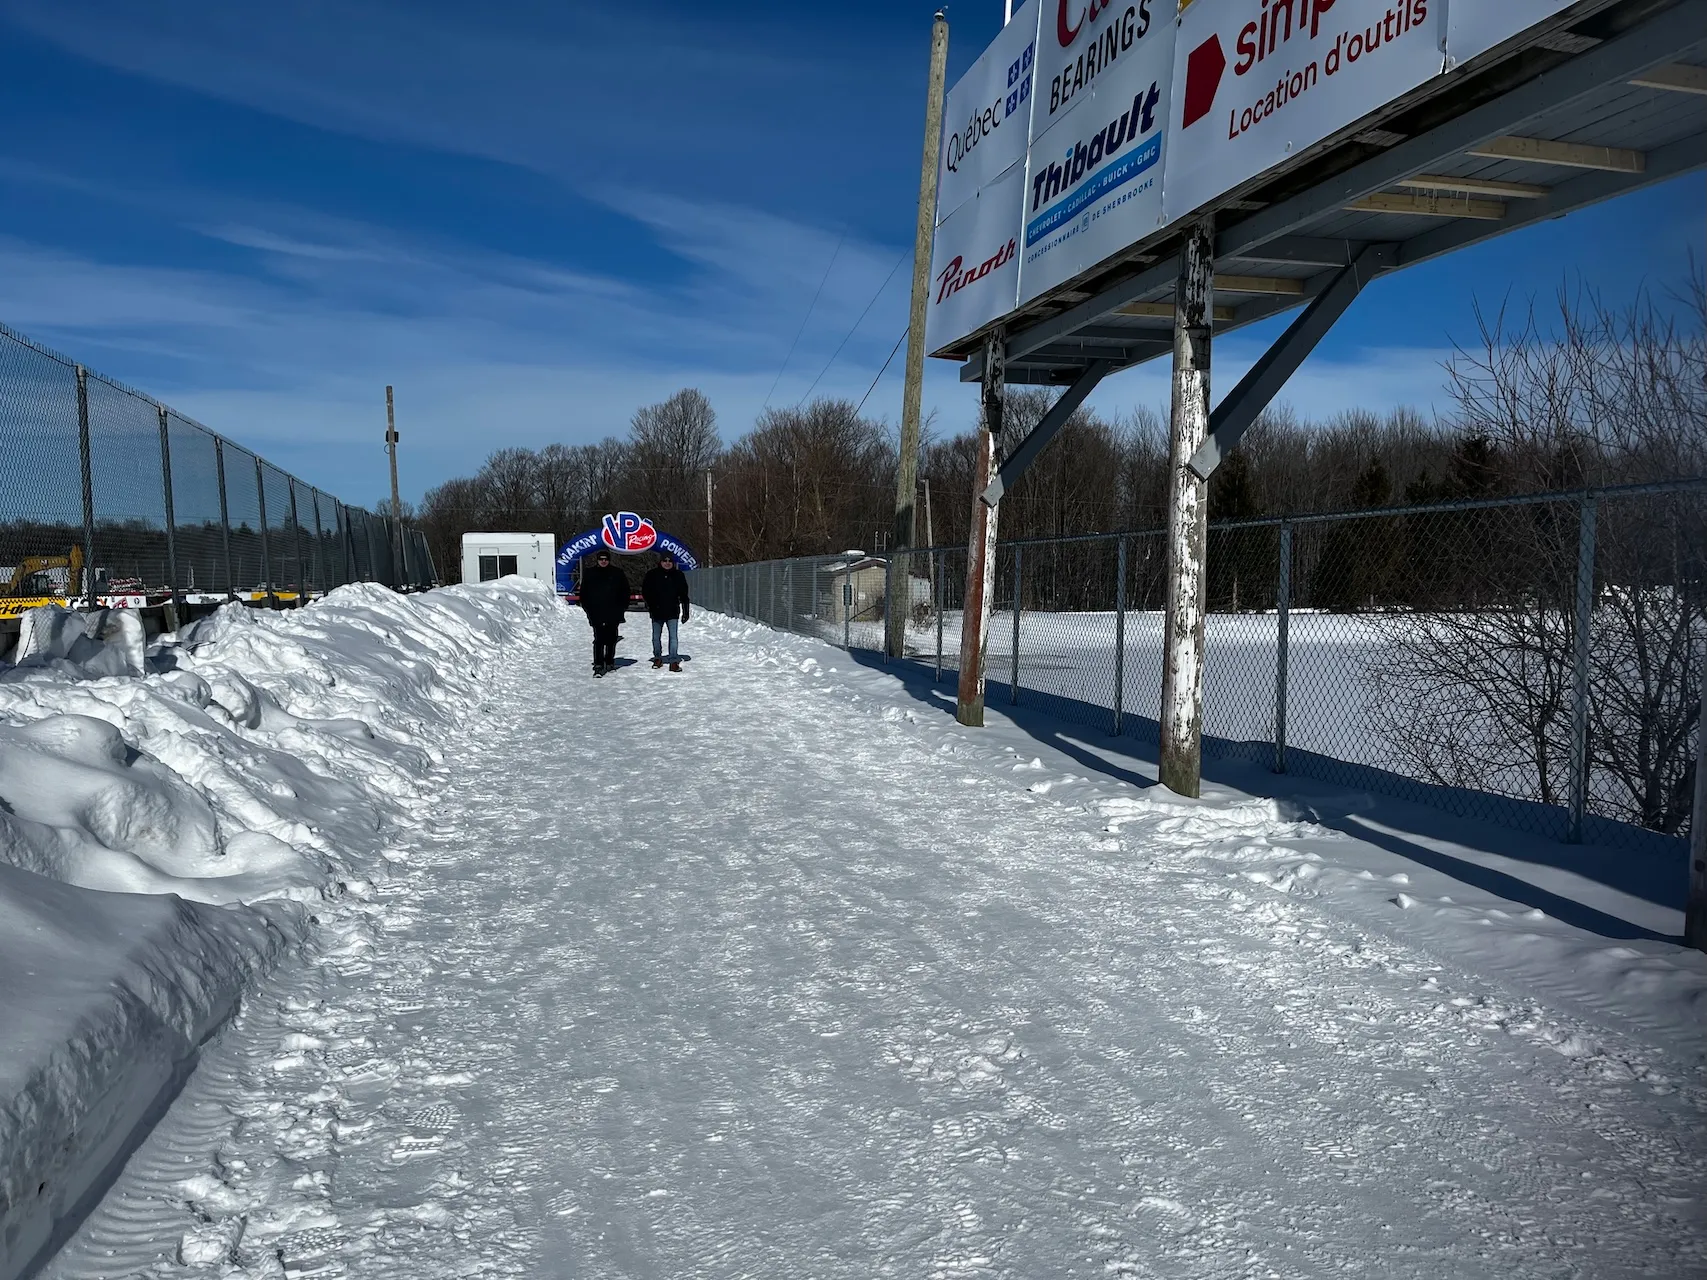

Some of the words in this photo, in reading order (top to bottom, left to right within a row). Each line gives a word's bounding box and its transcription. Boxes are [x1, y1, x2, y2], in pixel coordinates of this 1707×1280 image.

[1049, 0, 1152, 116] BEARINGS
[1228, 61, 1317, 140] Location
[1325, 0, 1427, 76] d'outils
[947, 98, 1002, 173] Québec
[1032, 80, 1160, 212] Thibault
[1027, 224, 1080, 263] CONCESSIONNAIRE
[1092, 211, 1101, 221] DE
[1102, 177, 1154, 215] SHERBROOKE
[1028, 210, 1062, 239] CHEVROLET
[1067, 184, 1097, 213] CADILLAC
[1102, 164, 1128, 187] BUICK
[1136, 145, 1156, 166] GMC
[936, 237, 1016, 305] Prinoth
[602, 511, 641, 550] VP
[629, 533, 655, 547] Racing
